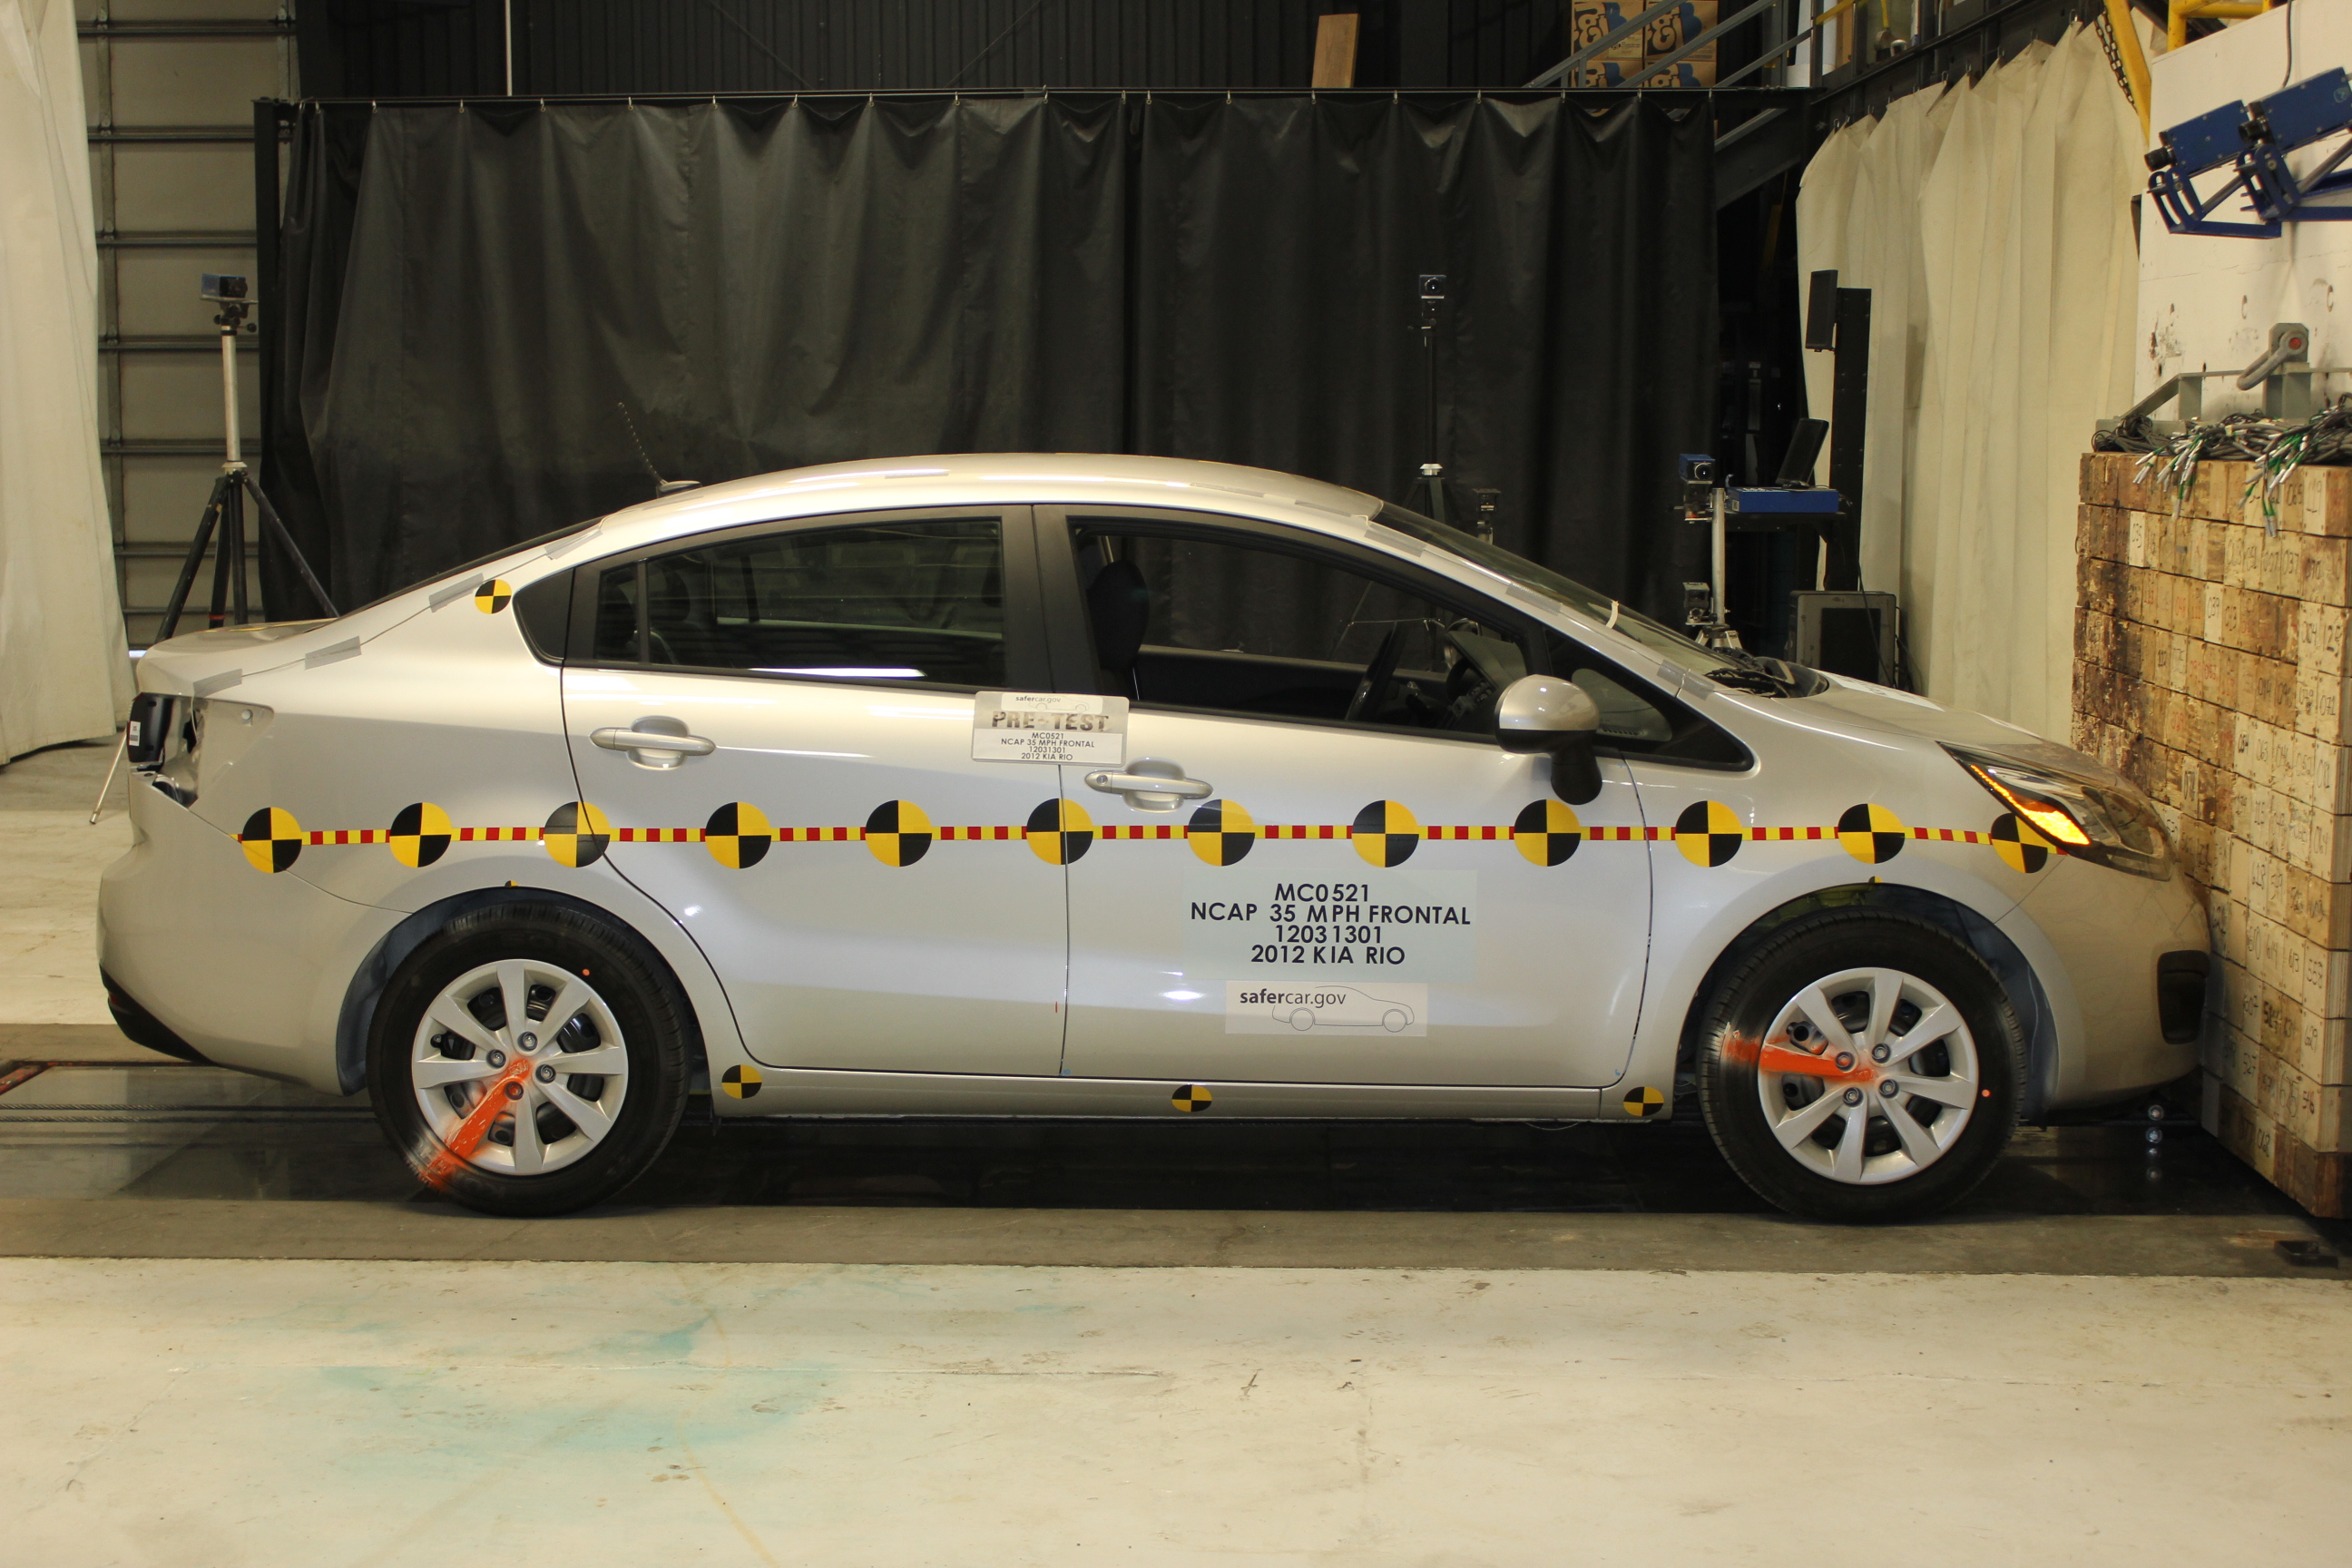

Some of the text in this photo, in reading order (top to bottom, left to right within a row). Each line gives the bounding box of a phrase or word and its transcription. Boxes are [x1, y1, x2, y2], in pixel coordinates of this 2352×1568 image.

[1015, 695, 1062, 703] safercar.gov
[992, 711, 1109, 731] PRE-TEST
[1001, 738, 1025, 746] NCAP
[1026, 739, 1037, 747] 35
[1029, 746, 1065, 754] 12031301
[1021, 752, 1041, 760] 2012
[1191, 902, 1471, 925] NCAP 35 MPH FRONTAL
[1276, 925, 1382, 944] 12031301
[1250, 945, 1406, 965] 2012 KIA RIO
[1240, 987, 1347, 1008] safercar.gov
